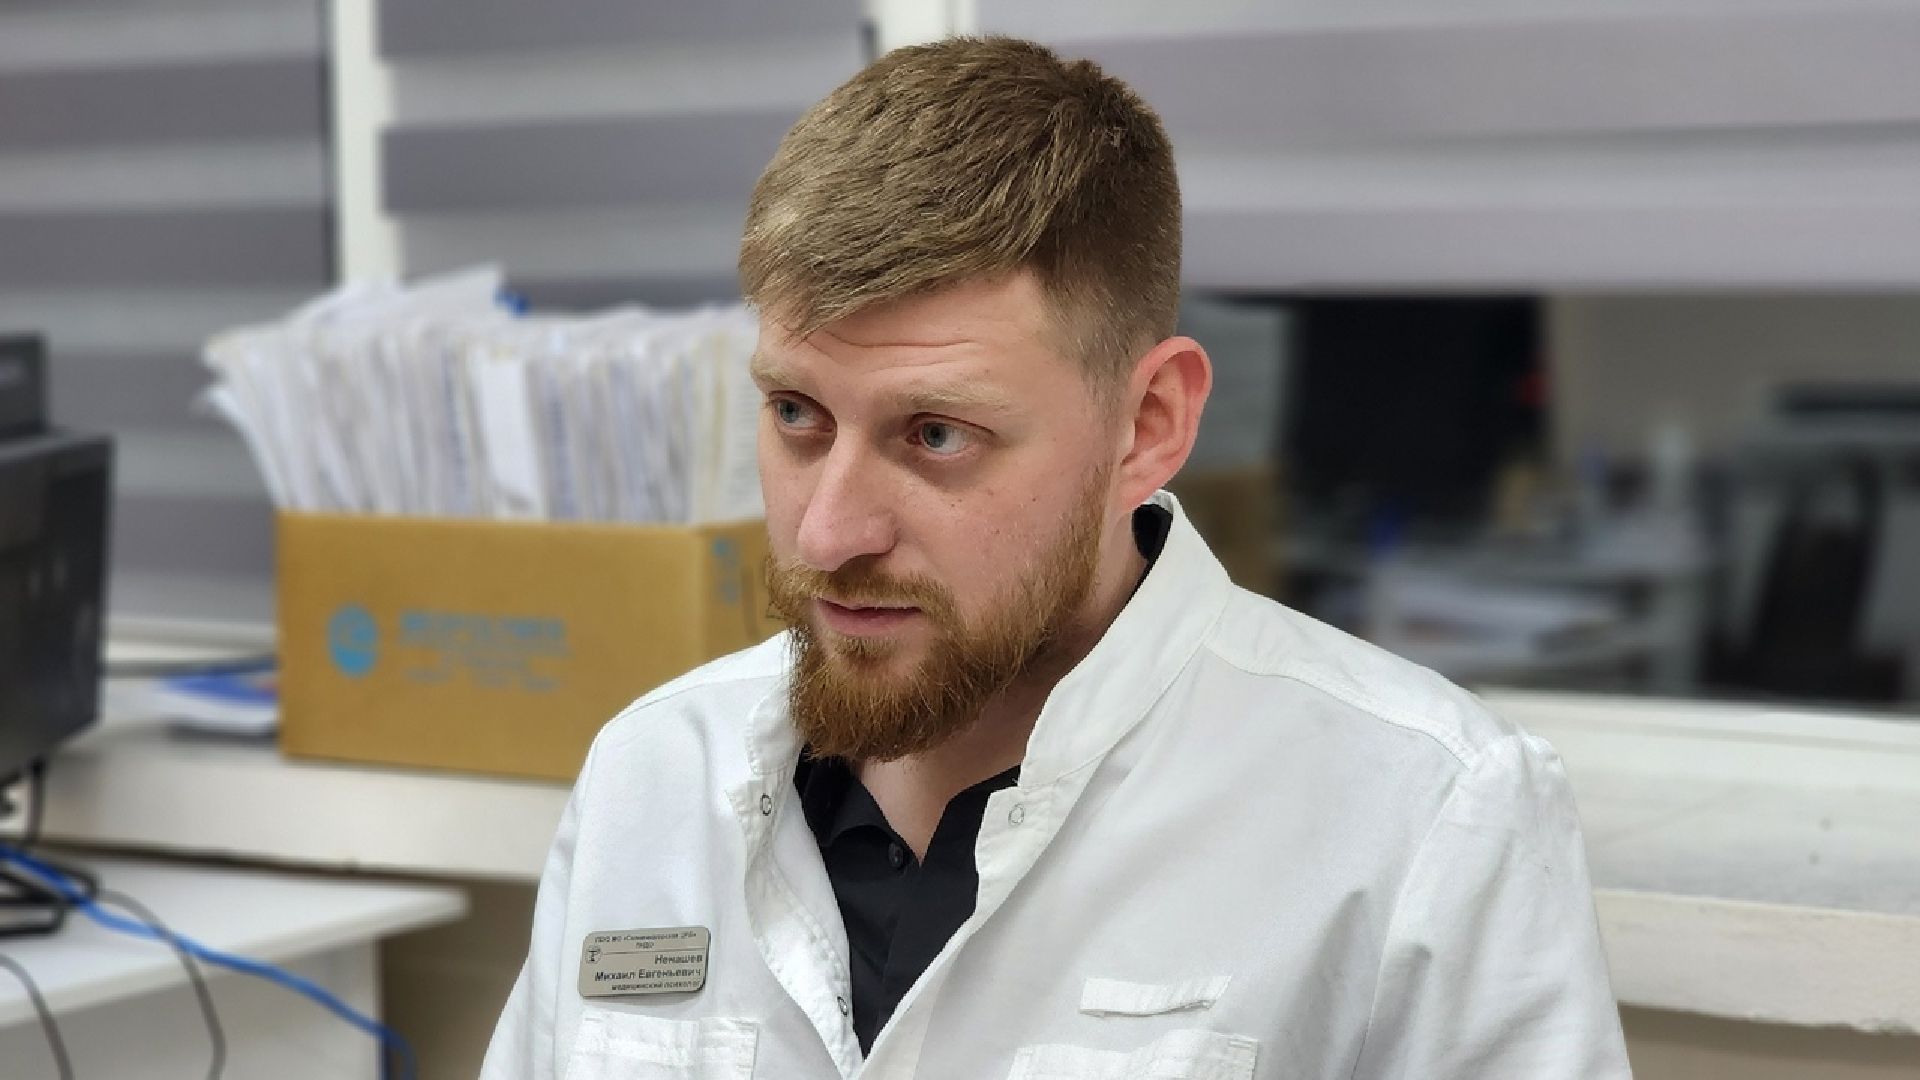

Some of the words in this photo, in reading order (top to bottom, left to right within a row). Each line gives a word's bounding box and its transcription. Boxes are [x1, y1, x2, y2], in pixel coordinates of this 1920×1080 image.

[655, 954, 703, 964] Ненашев
[595, 971, 635, 981] Михаил
[638, 969, 701, 979] Евгеньевич
